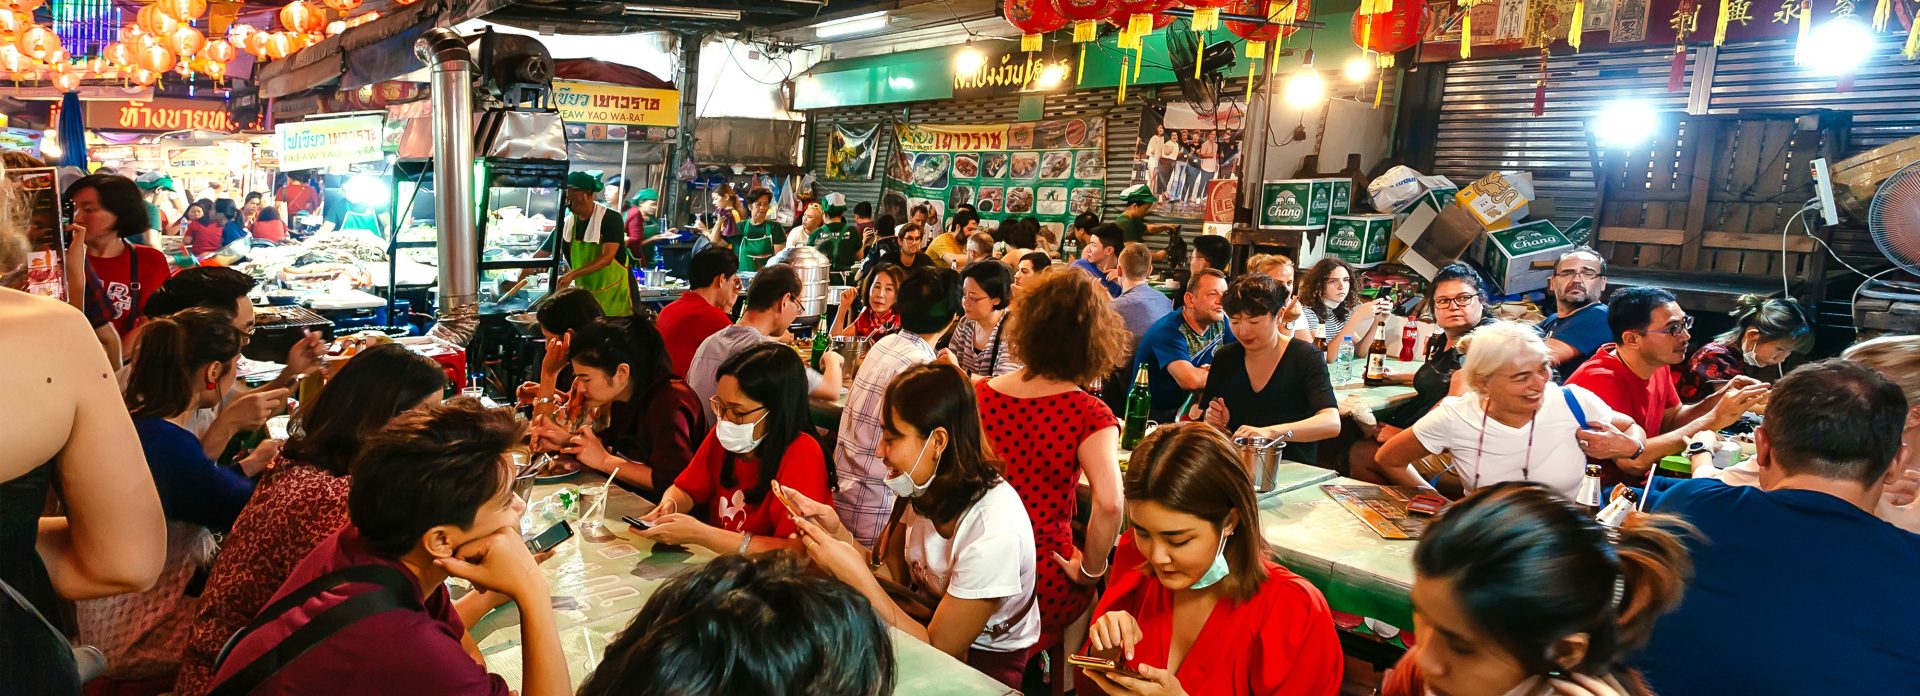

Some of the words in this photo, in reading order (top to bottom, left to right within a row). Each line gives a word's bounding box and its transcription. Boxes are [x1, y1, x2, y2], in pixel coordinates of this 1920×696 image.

[560, 110, 585, 119] EAW
[587, 111, 608, 121] YAO
[610, 112, 645, 123] WA-RAT
[1214, 199, 1236, 213] LE
[1267, 205, 1302, 218] Chang
[1311, 200, 1329, 211] Chang
[1330, 236, 1360, 249] Chang
[1512, 236, 1556, 249] Chang
